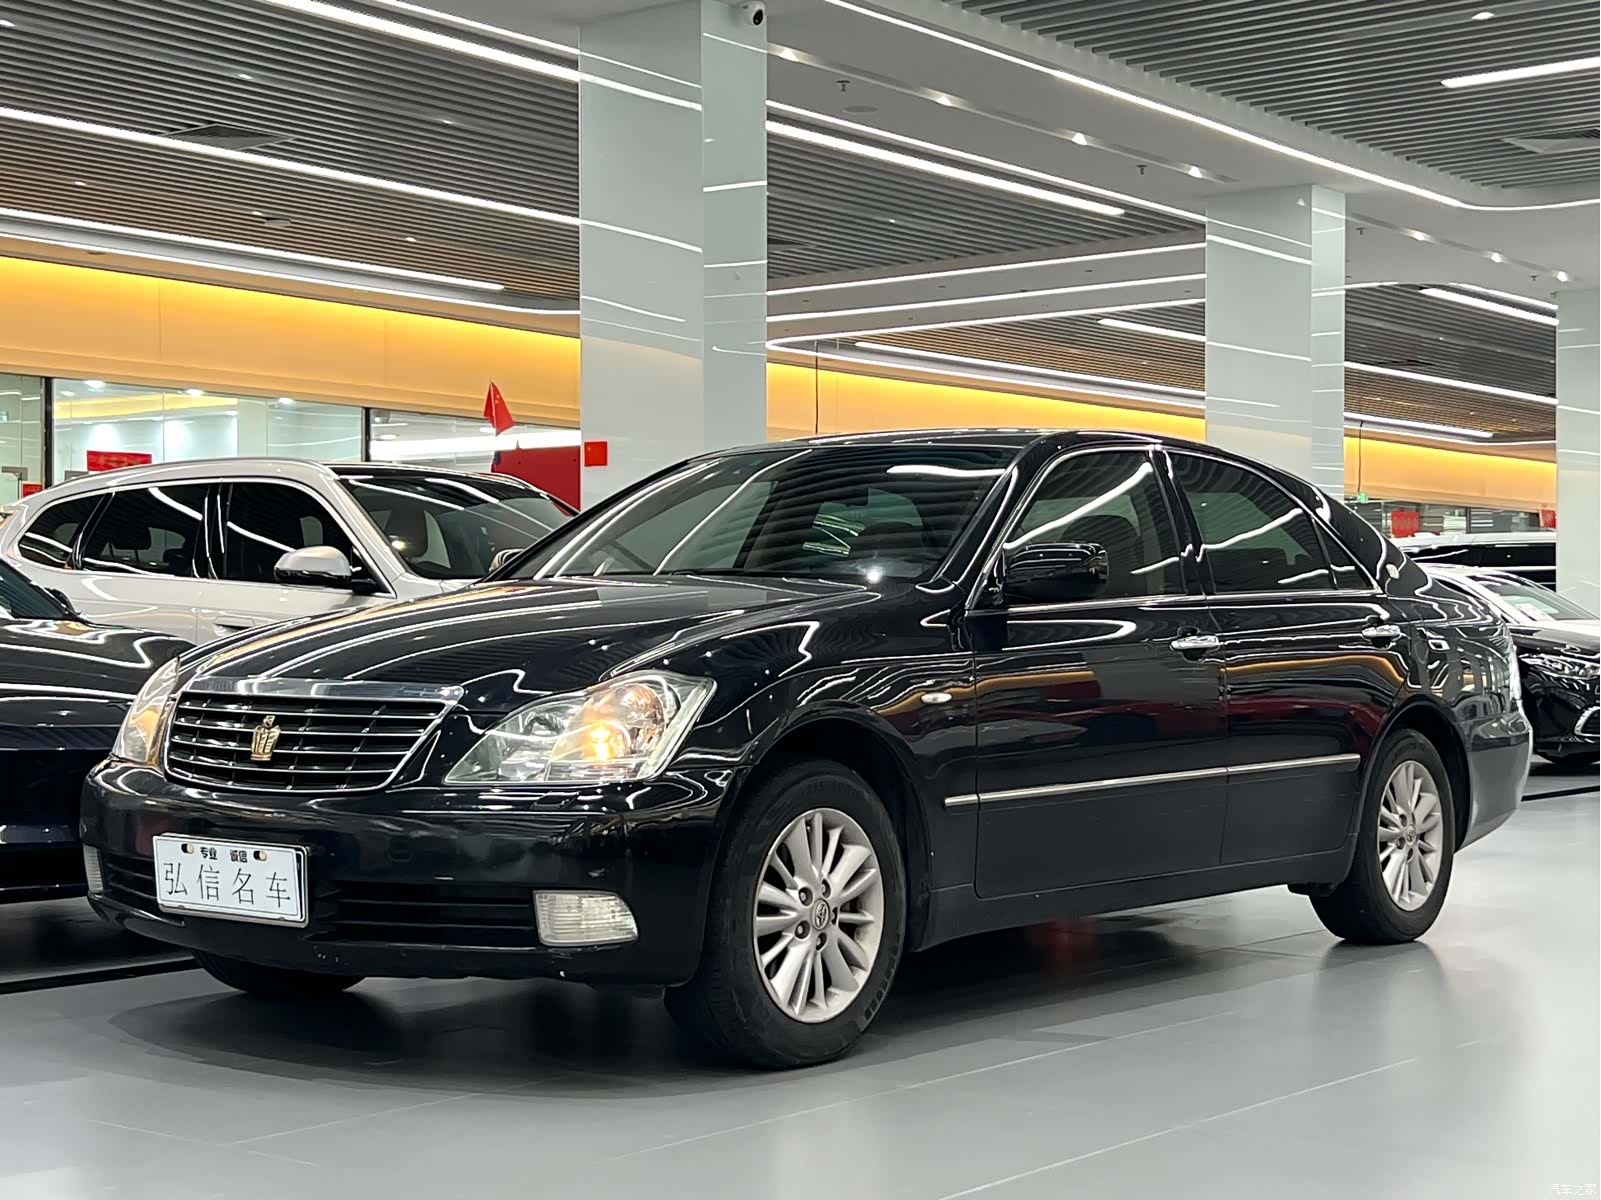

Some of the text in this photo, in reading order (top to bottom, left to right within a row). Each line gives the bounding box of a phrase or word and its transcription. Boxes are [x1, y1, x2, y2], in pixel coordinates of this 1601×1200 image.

[199, 847, 248, 863] 专业 诚信
[163, 862, 291, 908] 弘信名车
